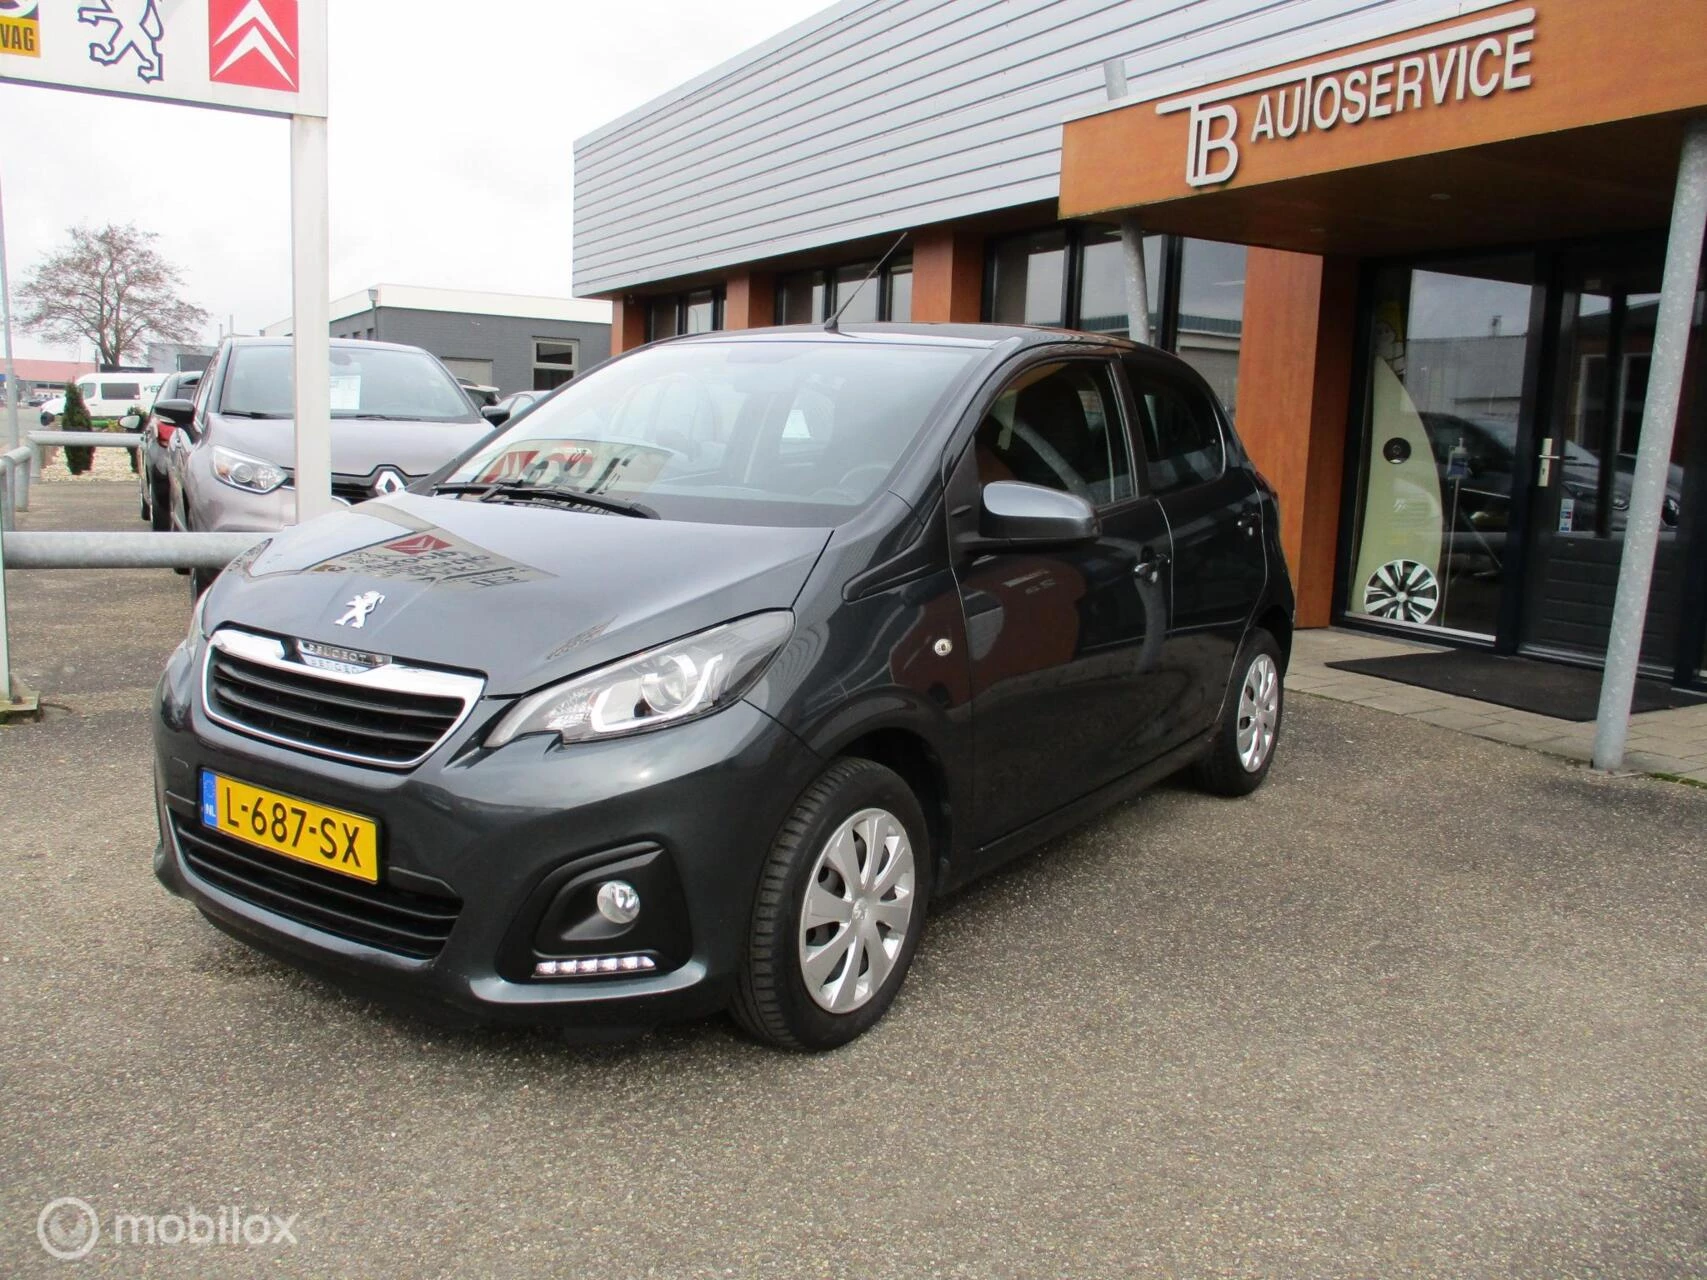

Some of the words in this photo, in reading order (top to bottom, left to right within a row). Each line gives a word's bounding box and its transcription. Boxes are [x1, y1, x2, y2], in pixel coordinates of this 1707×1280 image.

[1251, 29, 1535, 142] AUTOSERVICE
[204, 802, 216, 818] NL
[226, 786, 361, 868] L-687-SX
